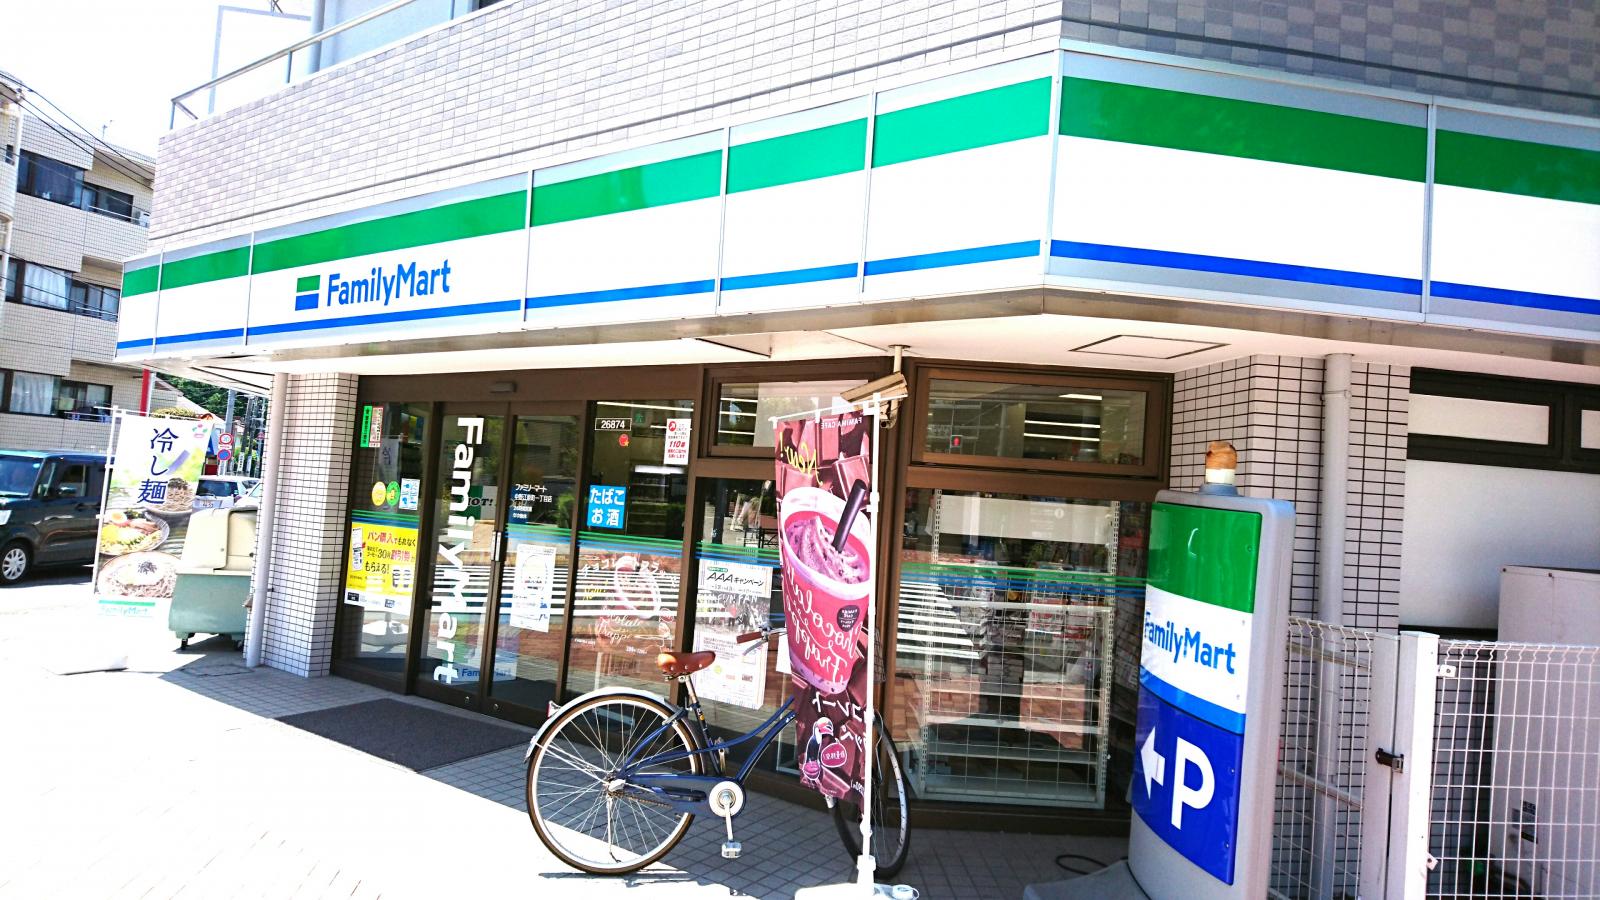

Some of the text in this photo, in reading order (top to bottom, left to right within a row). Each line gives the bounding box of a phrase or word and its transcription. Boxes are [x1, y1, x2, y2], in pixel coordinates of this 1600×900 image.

[326, 259, 452, 307] FamilyMart
[601, 419, 626, 429] 26874
[136, 427, 179, 505] 冷し麺
[590, 487, 625, 506] たばこ
[591, 507, 621, 527] お酒
[433, 416, 485, 685] FamilyMart
[707, 571, 764, 587] AAA キャンペーン
[1144, 611, 1236, 675] FamilyMart
[1170, 736, 1216, 830] P
